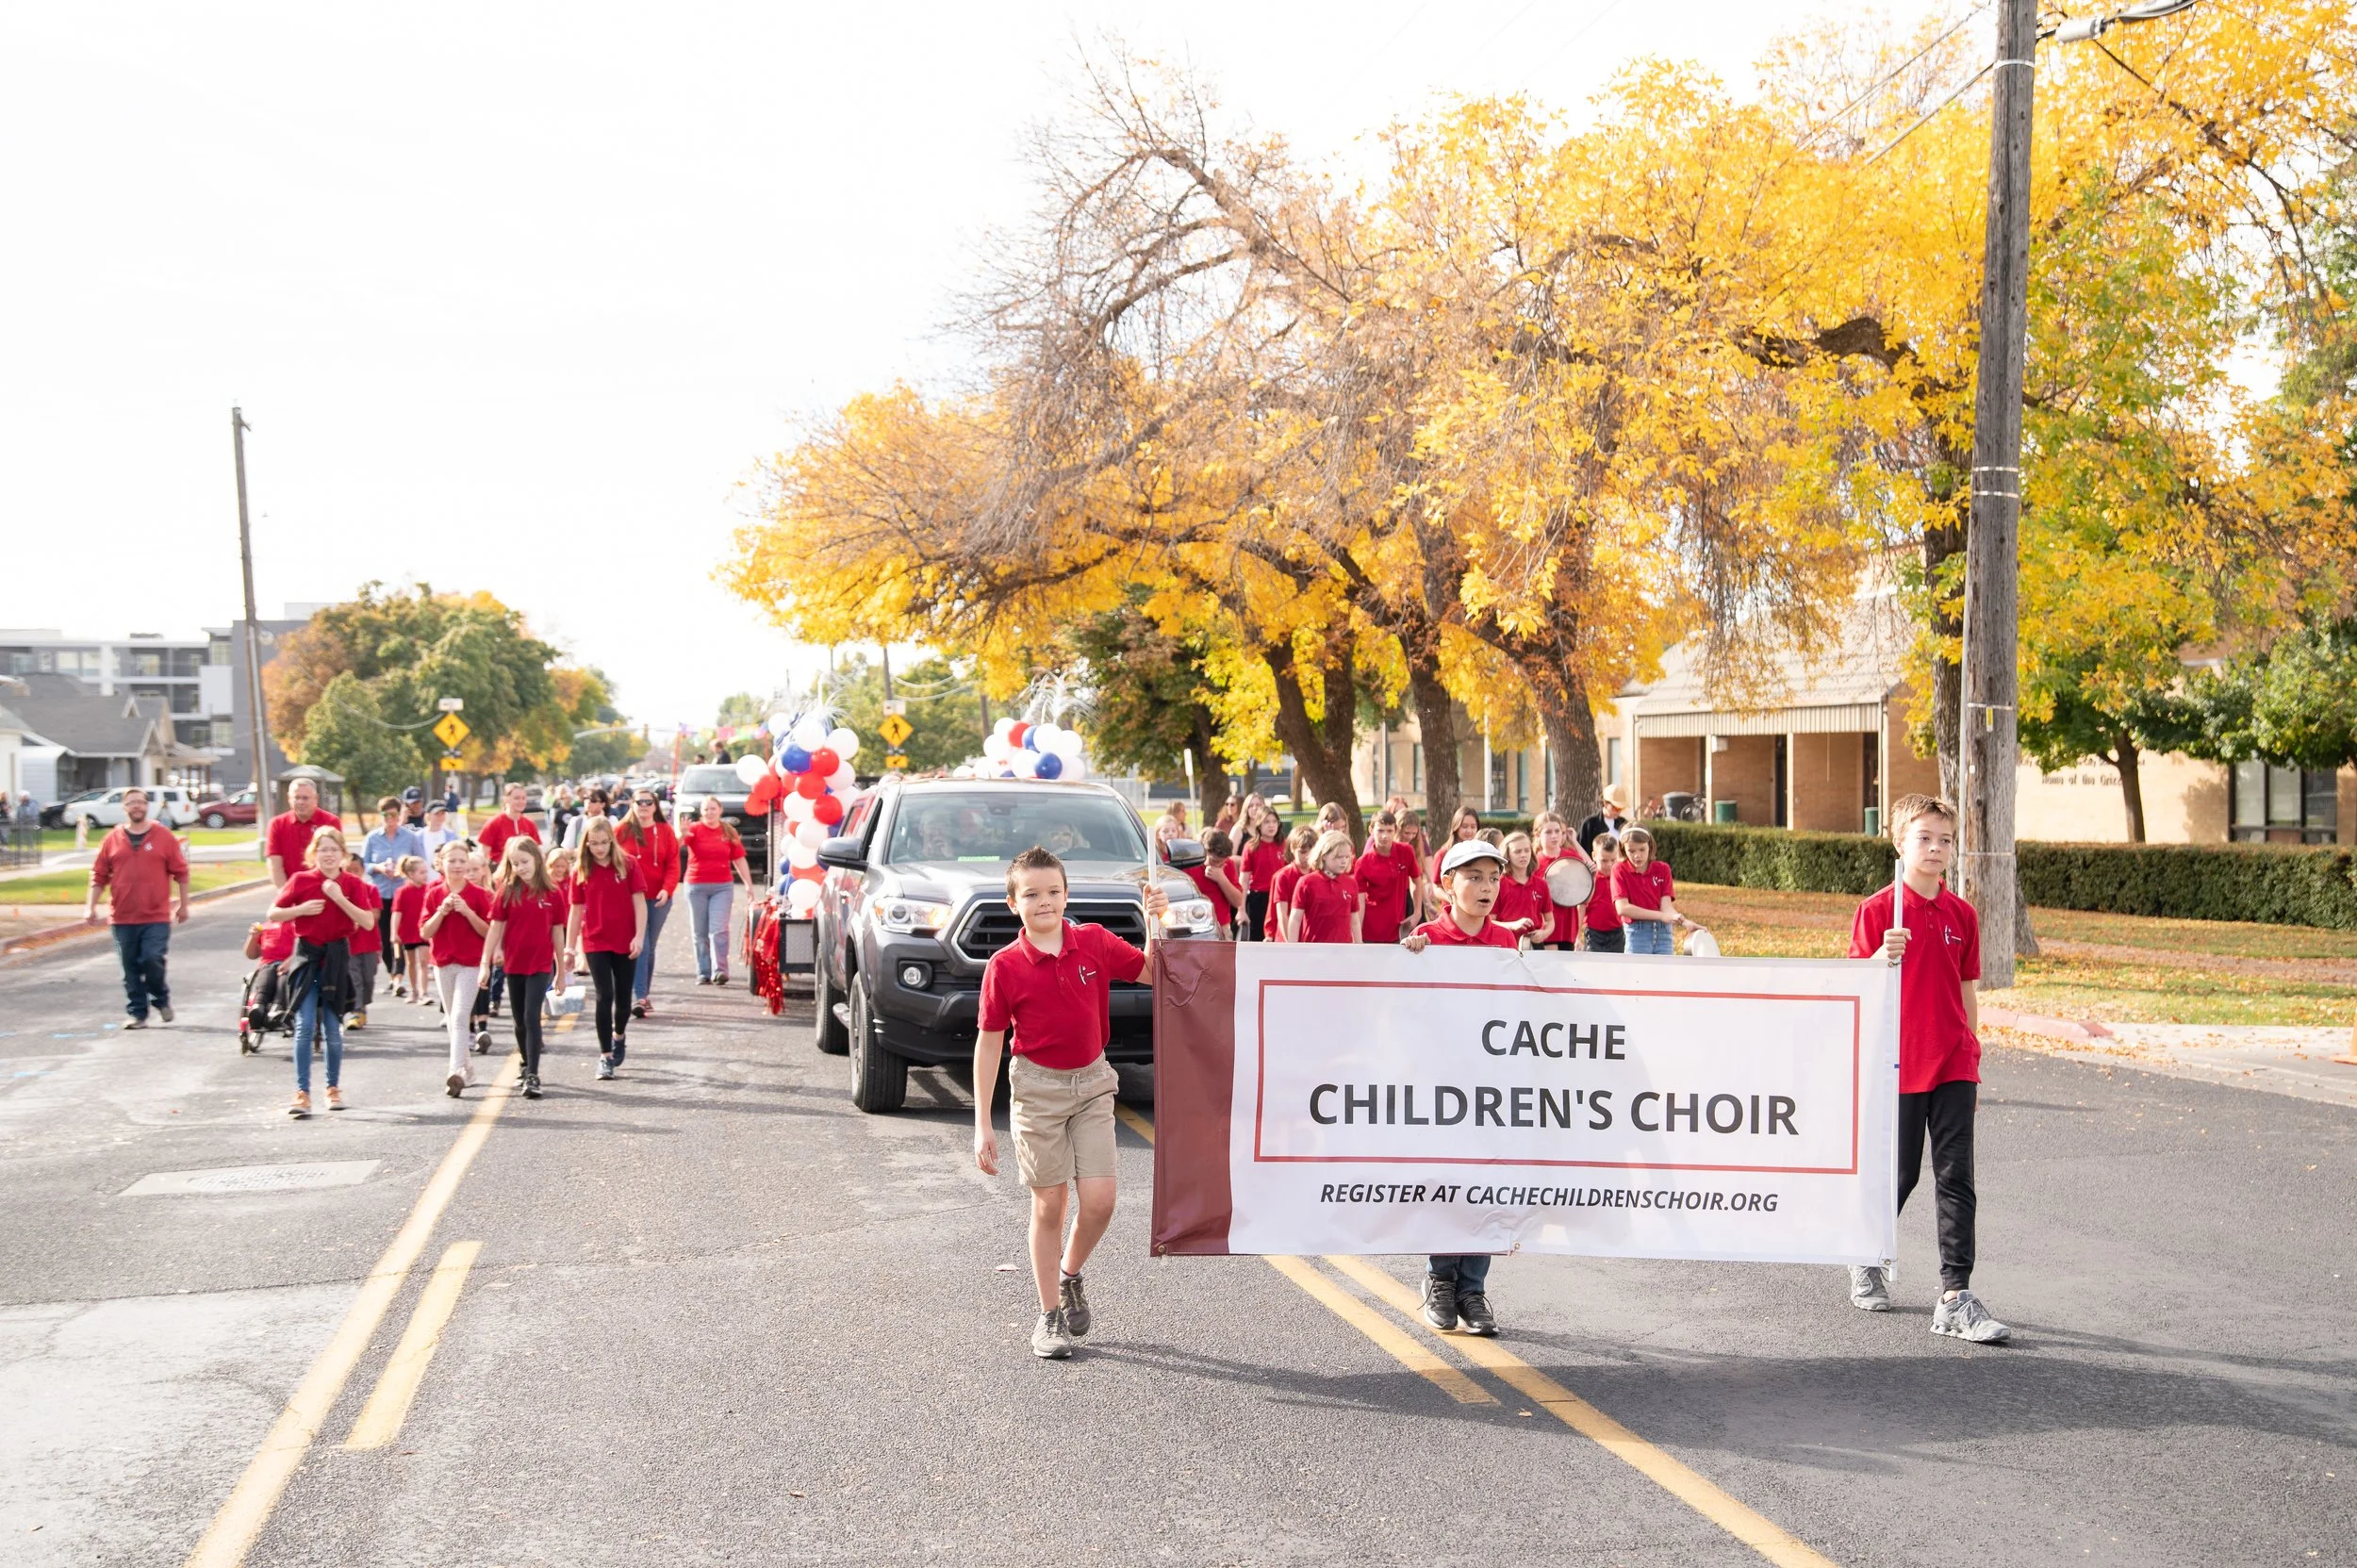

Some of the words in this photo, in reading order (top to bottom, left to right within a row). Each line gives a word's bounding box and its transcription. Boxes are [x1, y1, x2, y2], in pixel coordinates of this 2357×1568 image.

[2069, 772, 2077, 785] of
[2082, 773, 2095, 785] the
[1481, 1019, 1626, 1061] CACHE
[1310, 1083, 1613, 1131] CHILDREN'S
[1630, 1091, 1799, 1135] CHOIR
[1320, 1183, 1426, 1203] REGISTER
[1430, 1184, 1461, 1203] AT
[1466, 1185, 1778, 1212] CACHECHILDRENSCHOIR.ORG
